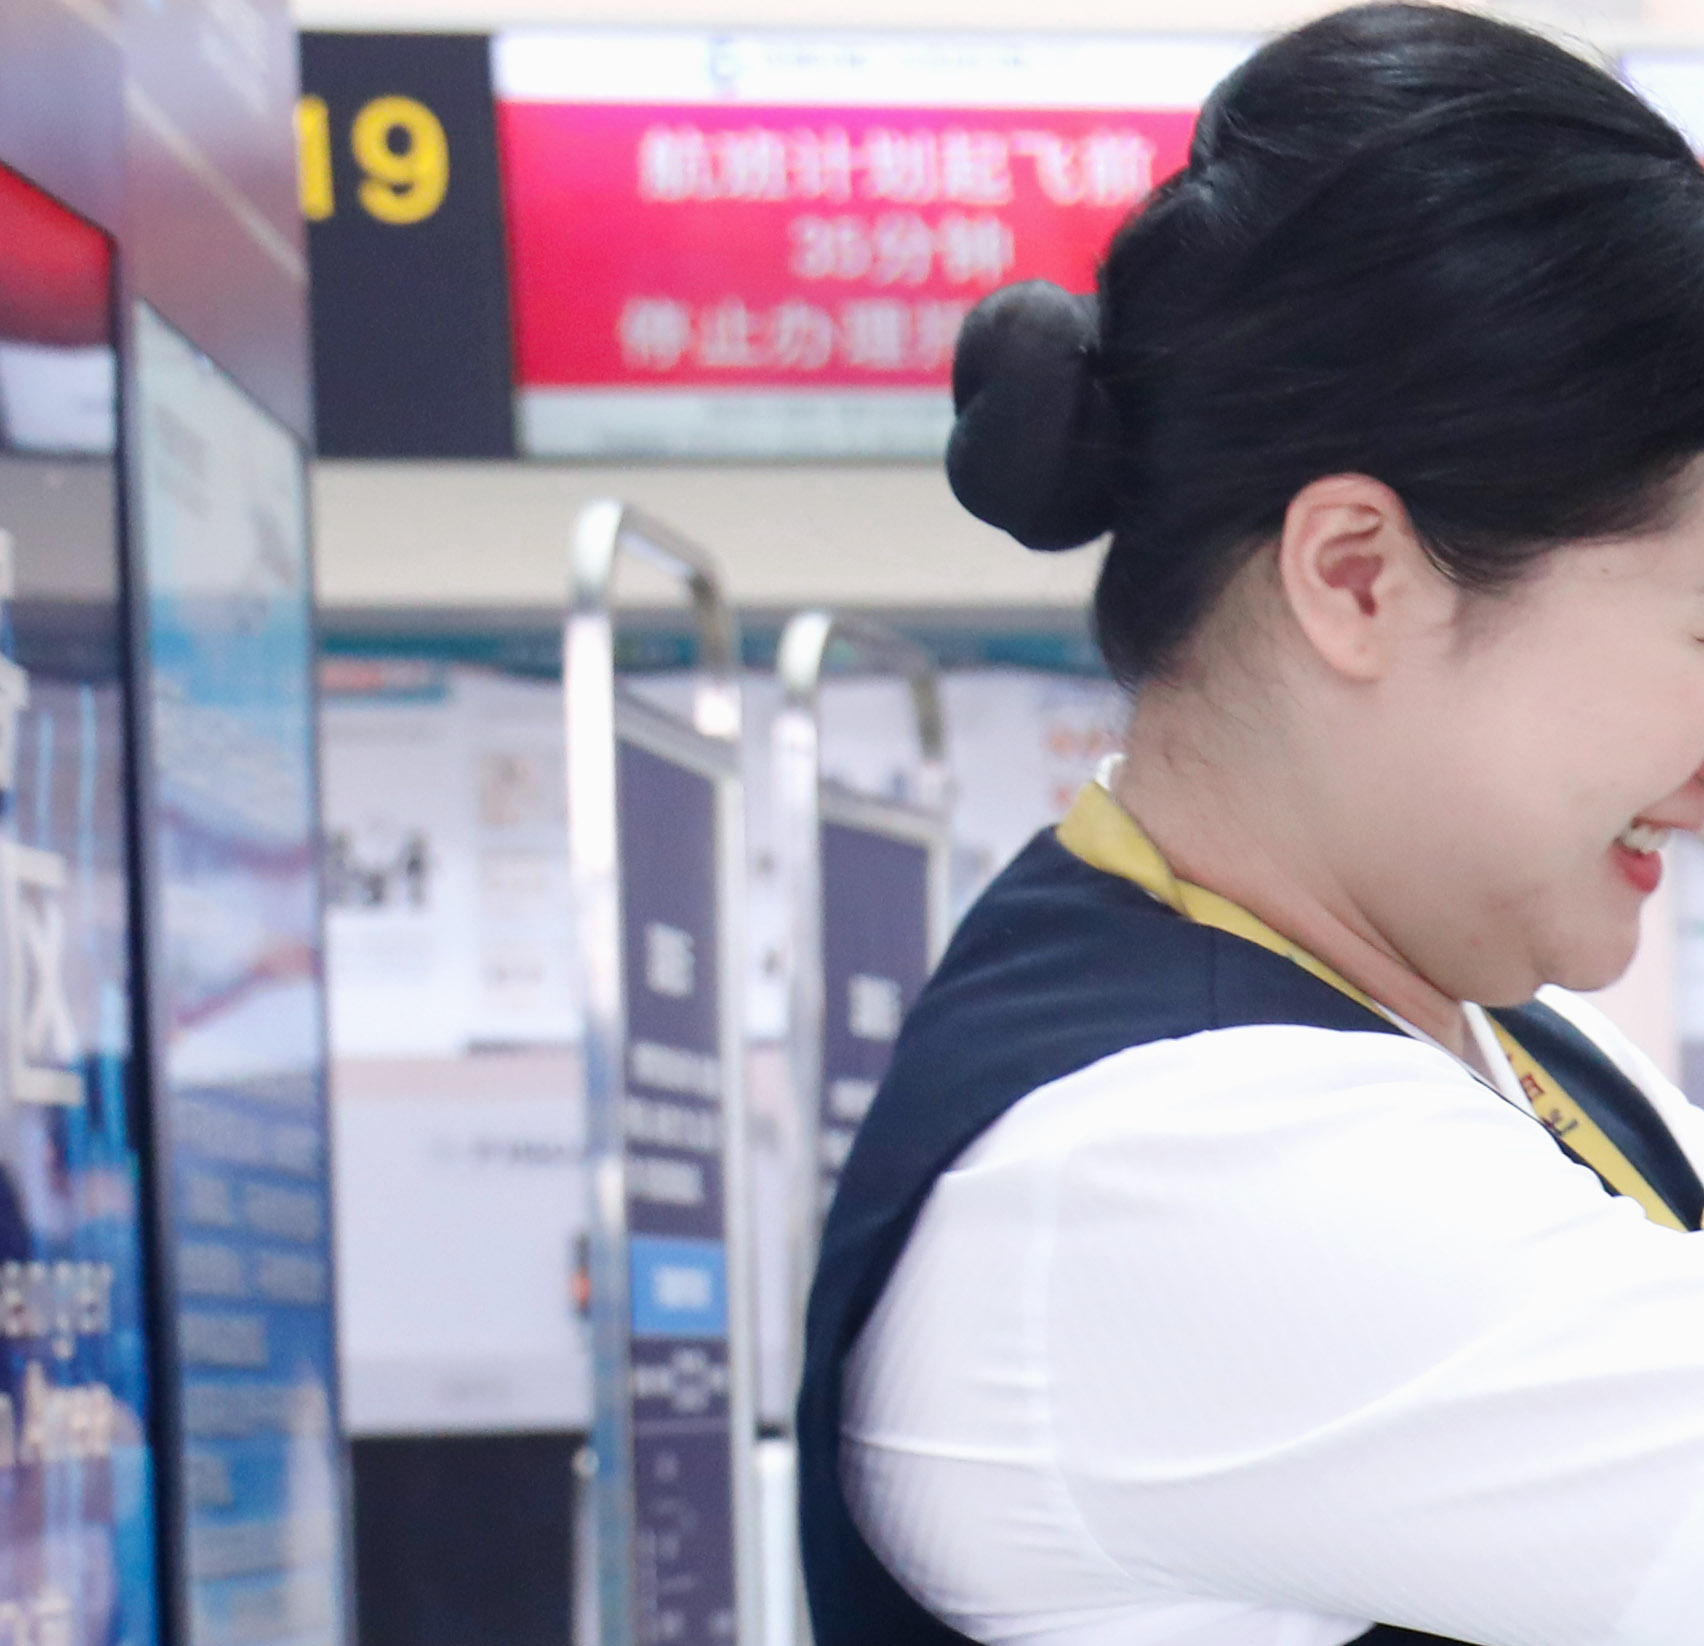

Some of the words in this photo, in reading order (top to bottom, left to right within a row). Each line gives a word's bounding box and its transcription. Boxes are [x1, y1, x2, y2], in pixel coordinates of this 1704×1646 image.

[294, 93, 449, 225] 19
[638, 123, 1156, 206] 航班计划起飞前
[790, 211, 1016, 286] 35分钟
